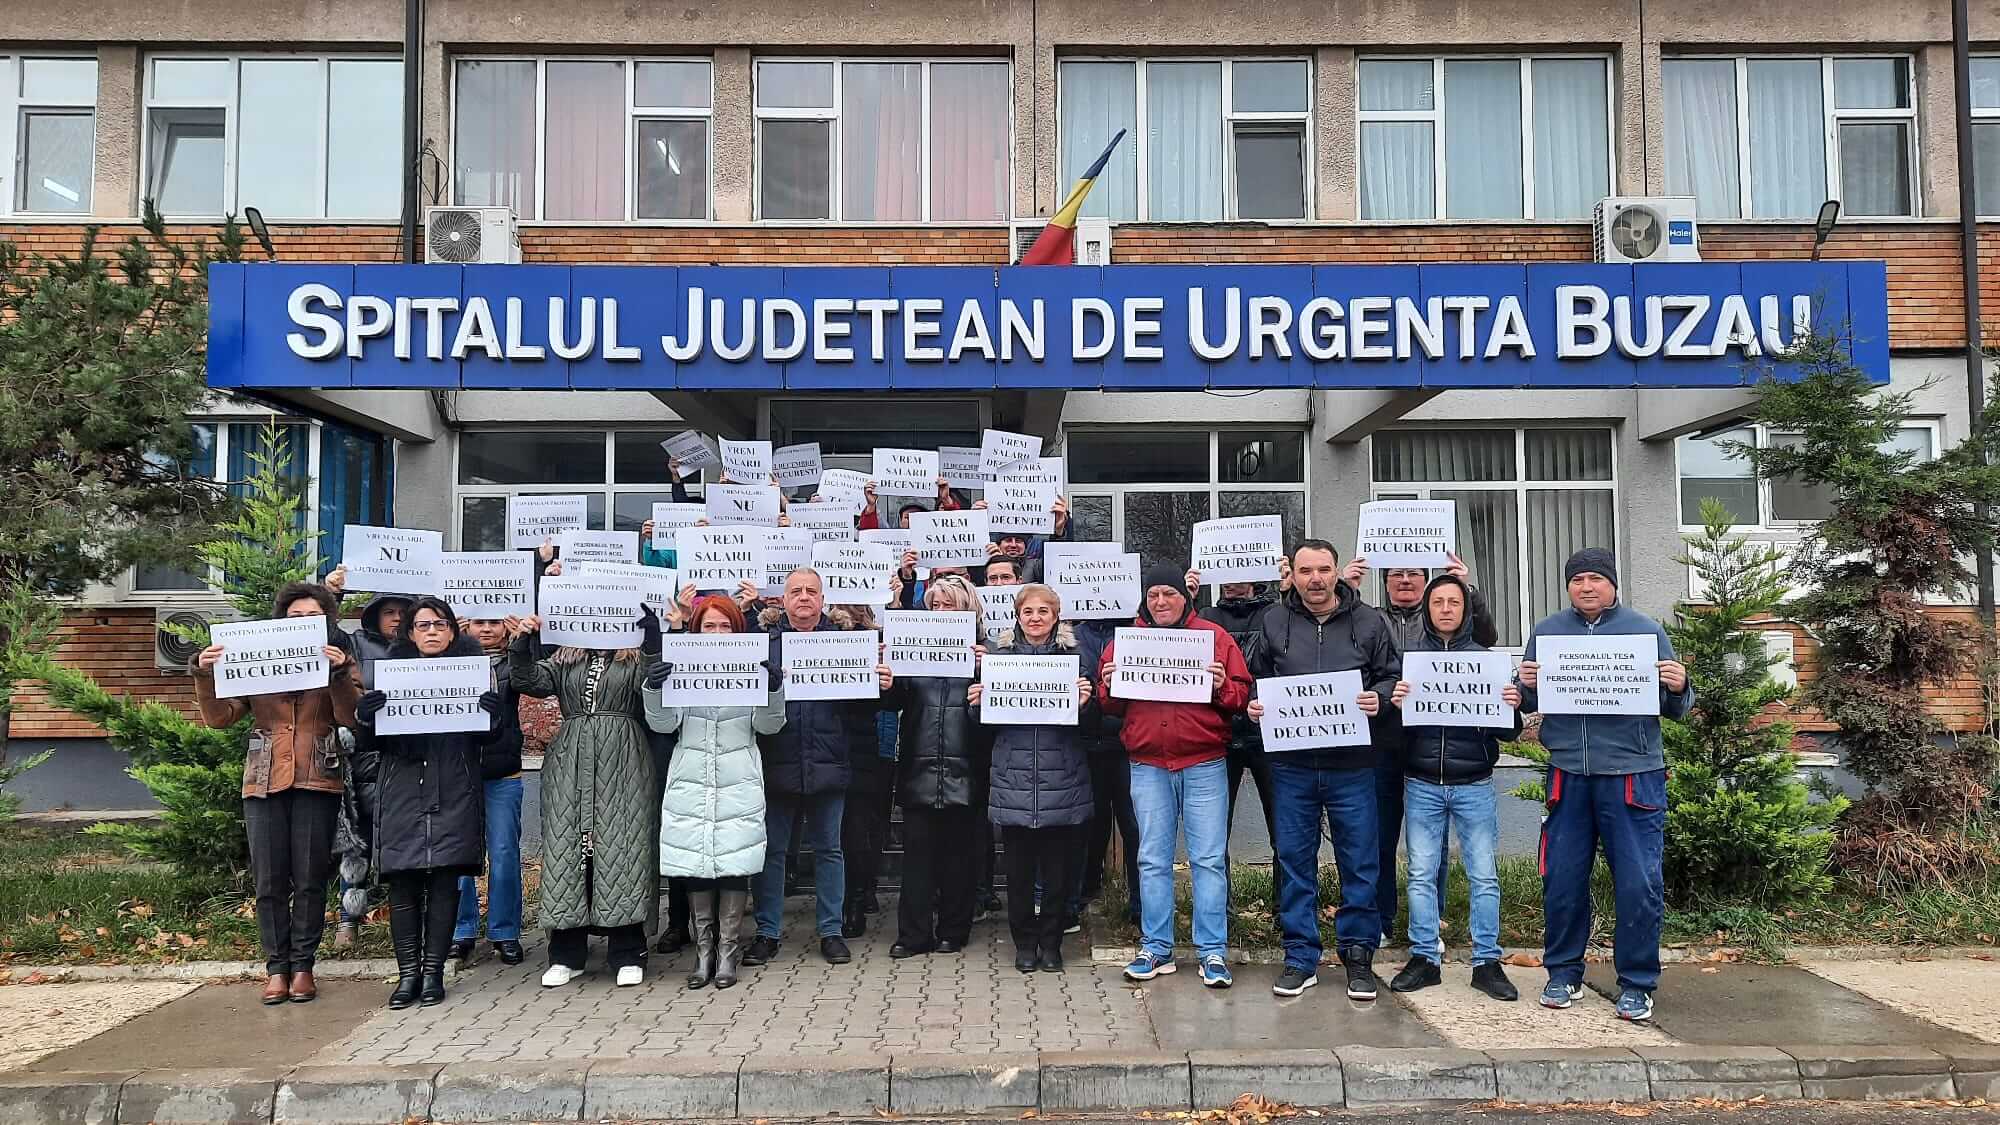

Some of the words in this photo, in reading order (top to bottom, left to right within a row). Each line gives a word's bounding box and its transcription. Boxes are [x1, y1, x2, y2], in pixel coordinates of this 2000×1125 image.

[1670, 229, 1691, 237] Haier
[285, 282, 641, 360] SPITALUL
[661, 285, 1045, 362] JUDETEAN
[1071, 297, 1164, 360] DE
[1188, 286, 1537, 361] URGENTA
[1555, 284, 1811, 359] BUZAU
[1001, 437, 1027, 448] VREM
[892, 455, 922, 464] VREM
[886, 468, 927, 477] SALARII
[880, 480, 931, 491] DECENTE!
[1004, 488, 1036, 498] VREM
[733, 499, 755, 511] NU
[997, 502, 1042, 512] SALARII
[932, 518, 968, 527] VREM
[992, 515, 1047, 526] DECENTE!
[814, 531, 849, 540] URESTI
[1377, 527, 1445, 536] DECEMBRIE
[703, 534, 744, 544] VREM
[926, 533, 975, 543] SALARII
[1211, 542, 1274, 552] DECEMBRIE
[1363, 542, 1446, 553] BUCURESTI
[378, 547, 408, 562] NU
[694, 551, 752, 562] SALARII
[839, 549, 865, 557] STOP
[921, 549, 982, 559] DECENTE!
[1198, 556, 1276, 569] BUCURESTI
[689, 568, 757, 579] DECENTE!
[457, 579, 524, 587] DECEMBRIE
[826, 576, 875, 589] TESA!
[444, 593, 526, 604] BUCURESTI
[549, 605, 561, 614] 12
[564, 605, 636, 616] DECEMBRIE
[1072, 599, 1122, 611] T.E.S.A
[549, 620, 635, 633] BUCURESTI
[893, 636, 902, 645] 12
[905, 637, 967, 646] DECEMBRIE
[225, 652, 236, 662] 12
[240, 646, 318, 660] DECEMBRIE
[891, 650, 967, 662] BUCURESTI
[792, 659, 802, 667] 12
[806, 658, 869, 667] DECEMBRIE
[1123, 655, 1132, 664] 12
[1136, 656, 1203, 668] DECEMBRIE
[225, 660, 320, 680] BUCURESTI
[674, 663, 684, 672] 12
[688, 663, 759, 672] DECEMBRIE
[1431, 661, 1481, 674] VREM
[791, 672, 871, 684] BUCURESTI
[1121, 671, 1204, 685] BUCURESTI
[672, 679, 760, 690] BUCURESTI
[991, 681, 1001, 690] 12
[1004, 682, 1070, 691] DECEMBRIE
[1422, 682, 1491, 695] SALARII
[387, 689, 398, 698] 12
[403, 687, 479, 698] DECEMBRIE
[1285, 684, 1333, 698] VREM
[990, 696, 1070, 709] BUCURESTI
[387, 702, 481, 717] BUCURESTI
[1278, 703, 1345, 719] SALARII
[1415, 701, 1500, 716] DECENTE!
[1273, 722, 1357, 739] DECENTE!
